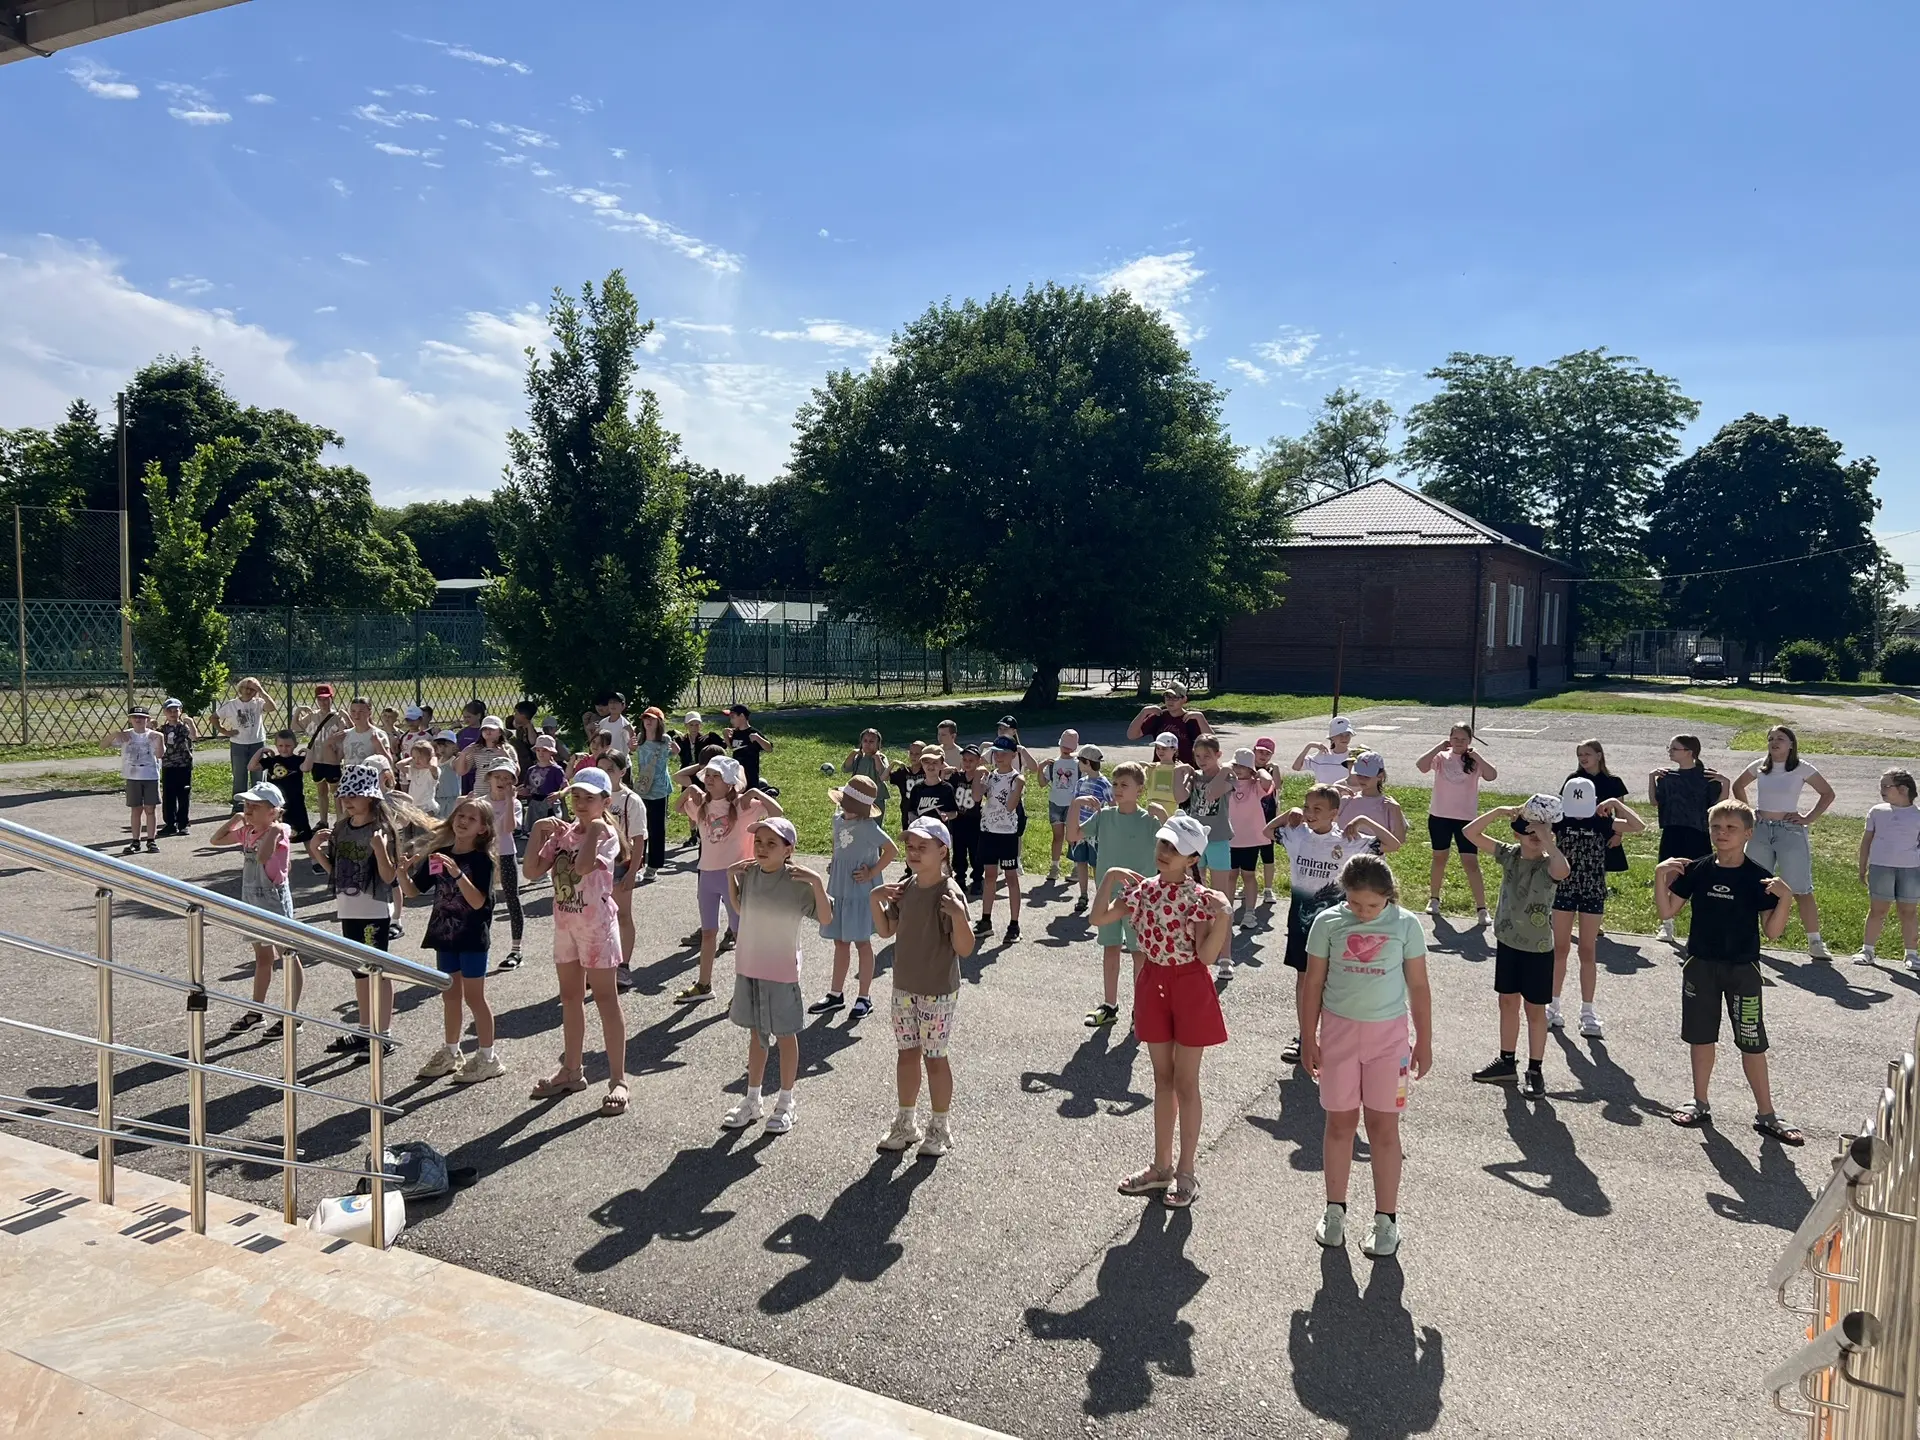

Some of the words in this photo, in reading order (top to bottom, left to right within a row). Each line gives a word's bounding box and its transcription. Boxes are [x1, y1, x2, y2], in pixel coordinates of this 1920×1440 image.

[919, 796, 940, 808] NIKE
[1001, 859, 1016, 867] JUST
[1296, 855, 1339, 871] Emirates
[1299, 866, 1308, 876] FLY
[1308, 868, 1330, 878] BETTER
